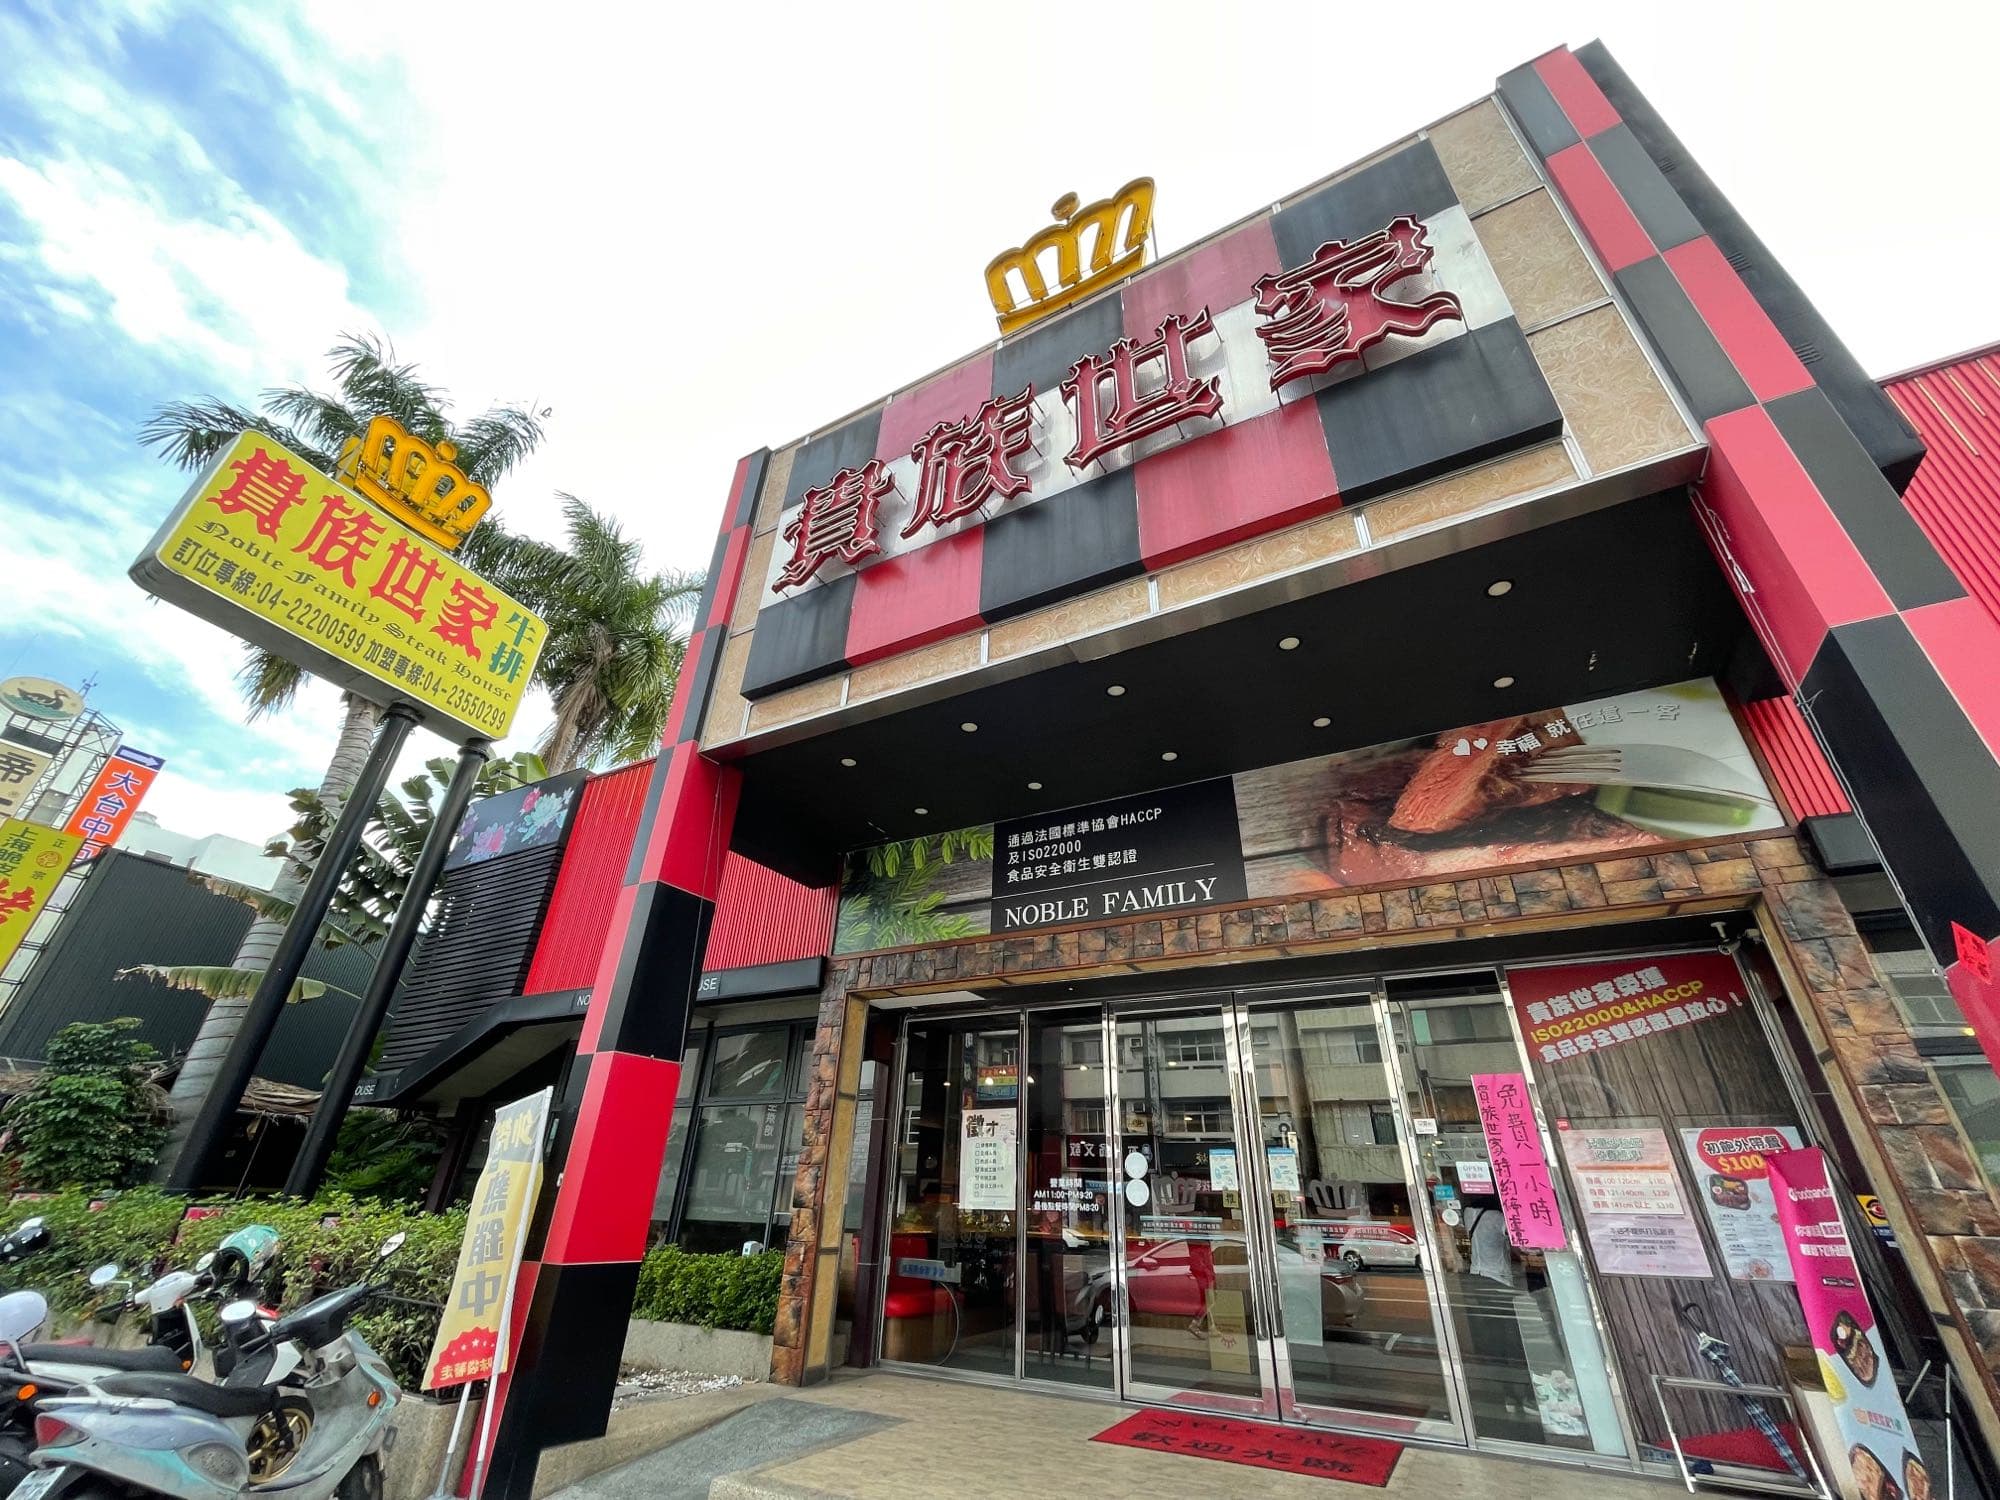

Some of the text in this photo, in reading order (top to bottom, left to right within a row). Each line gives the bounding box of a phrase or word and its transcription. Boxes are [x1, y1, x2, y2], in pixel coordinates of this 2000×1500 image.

[772, 214, 1463, 594] 貴族世家
[206, 447, 502, 662] 貴族世家
[195, 519, 512, 701] Noble Family Steak House
[488, 611, 536, 684] 牛排
[1007, 808, 1162, 848] 通過法國標準協會HACCP
[1007, 840, 1082, 865] 及ISO22000
[1007, 849, 1137, 883] 食品安全衛生雙認證
[1004, 877, 1218, 928] NOBLE FAMILY
[1526, 966, 1668, 1024] 貴族世家榮獲
[1530, 980, 1704, 1043] ISO22000&HACCP
